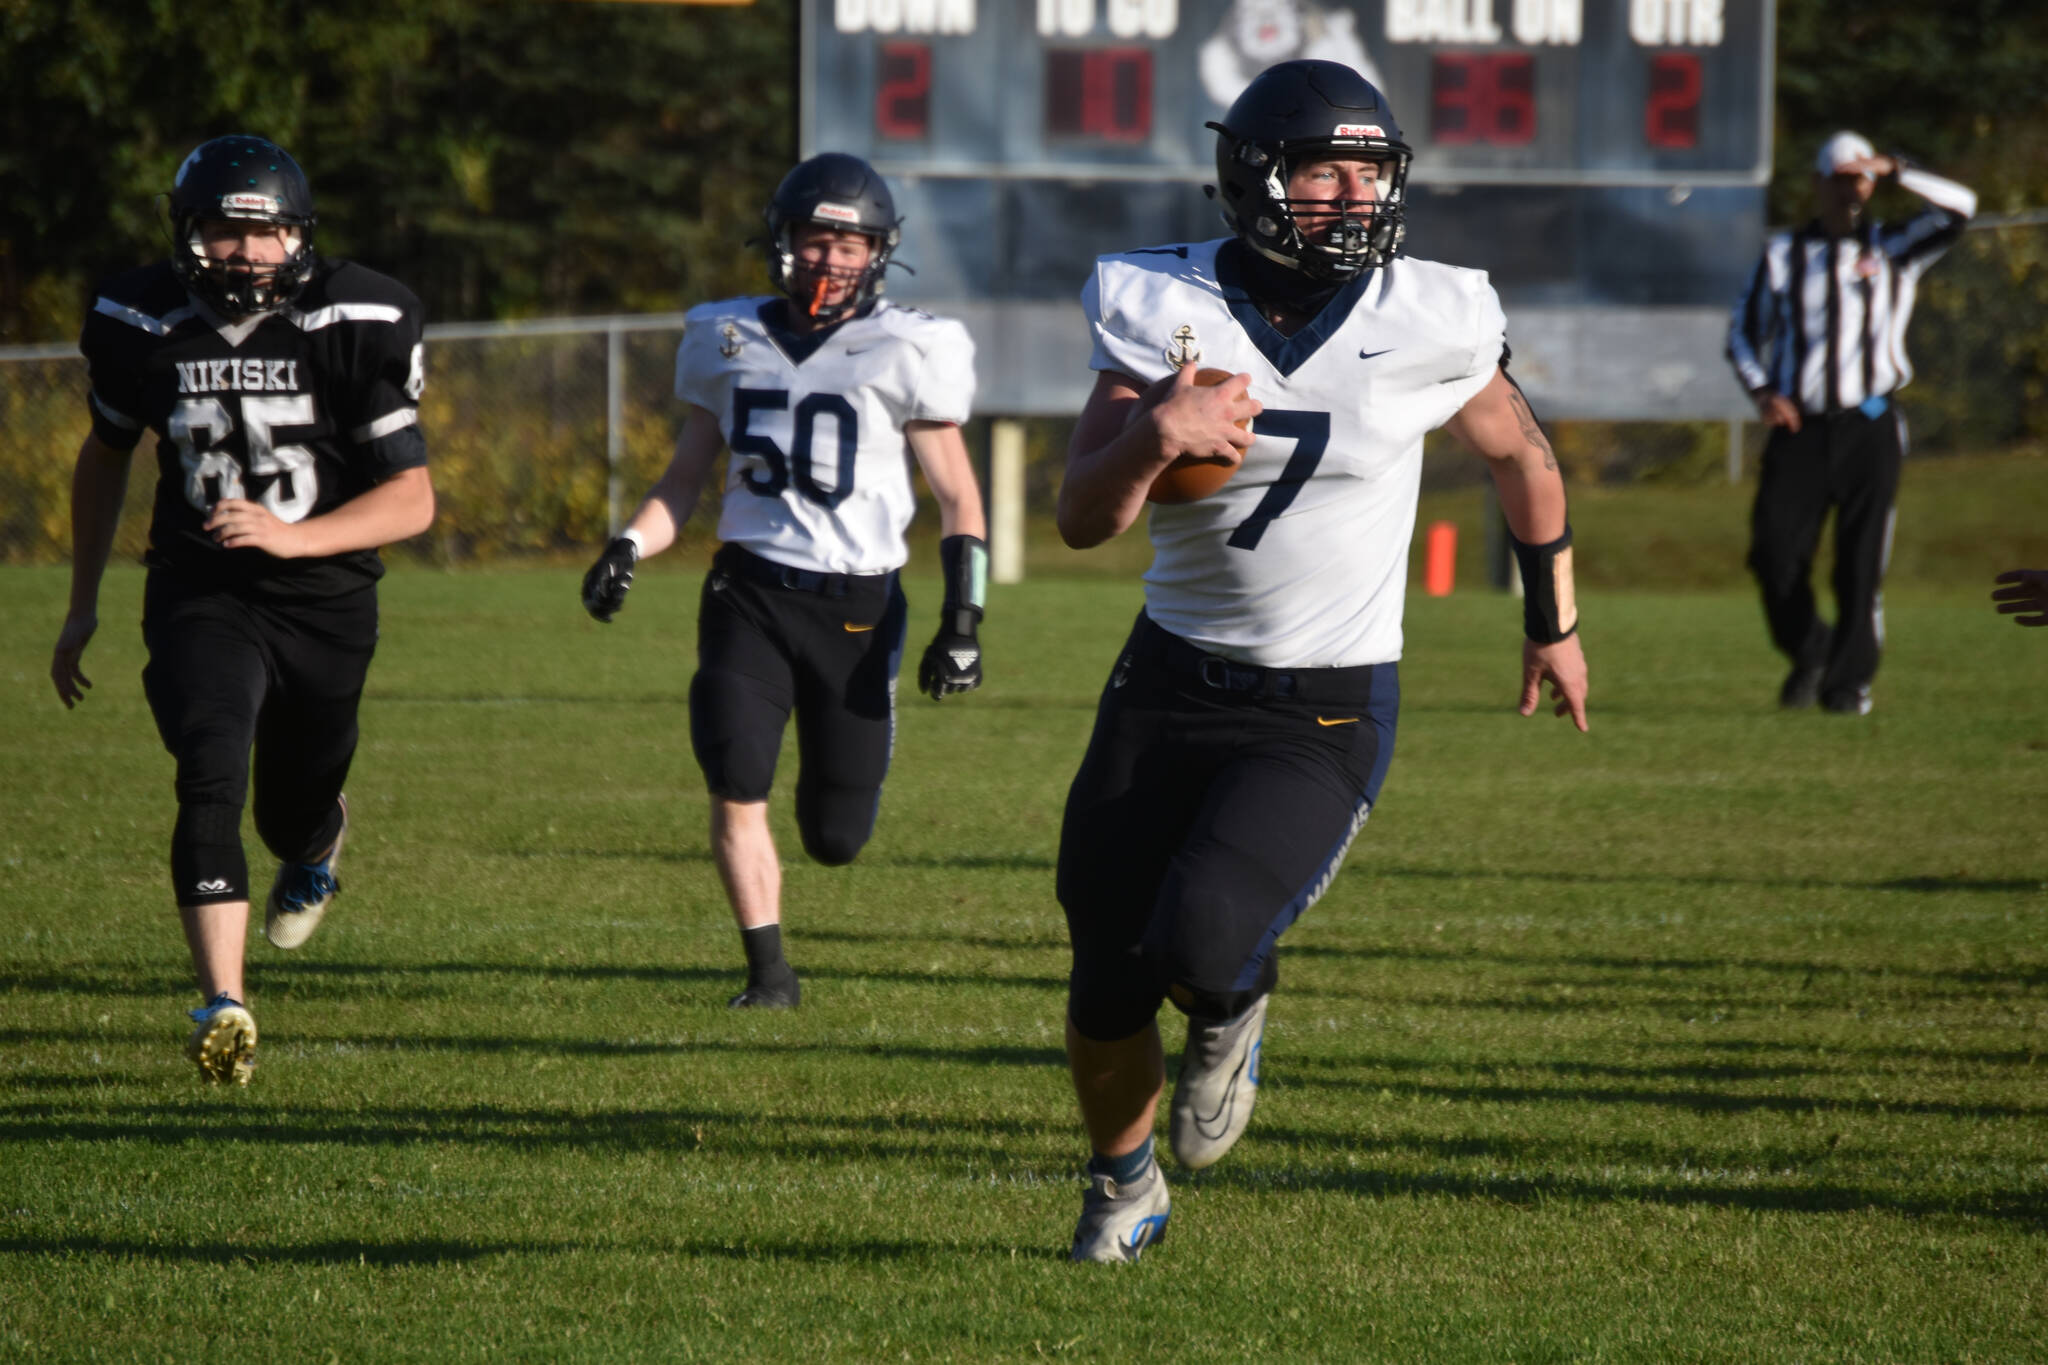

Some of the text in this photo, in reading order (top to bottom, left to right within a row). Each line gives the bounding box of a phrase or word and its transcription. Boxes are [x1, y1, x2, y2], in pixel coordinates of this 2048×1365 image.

[876, 42, 932, 139] 2
[1080, 47, 1155, 144] 10
[1432, 54, 1537, 147] 36
[1645, 54, 1702, 148] 2
[175, 358, 299, 393] NIKISKI
[168, 394, 318, 524] 65
[730, 387, 858, 511] 50
[1226, 408, 1331, 552] 7
